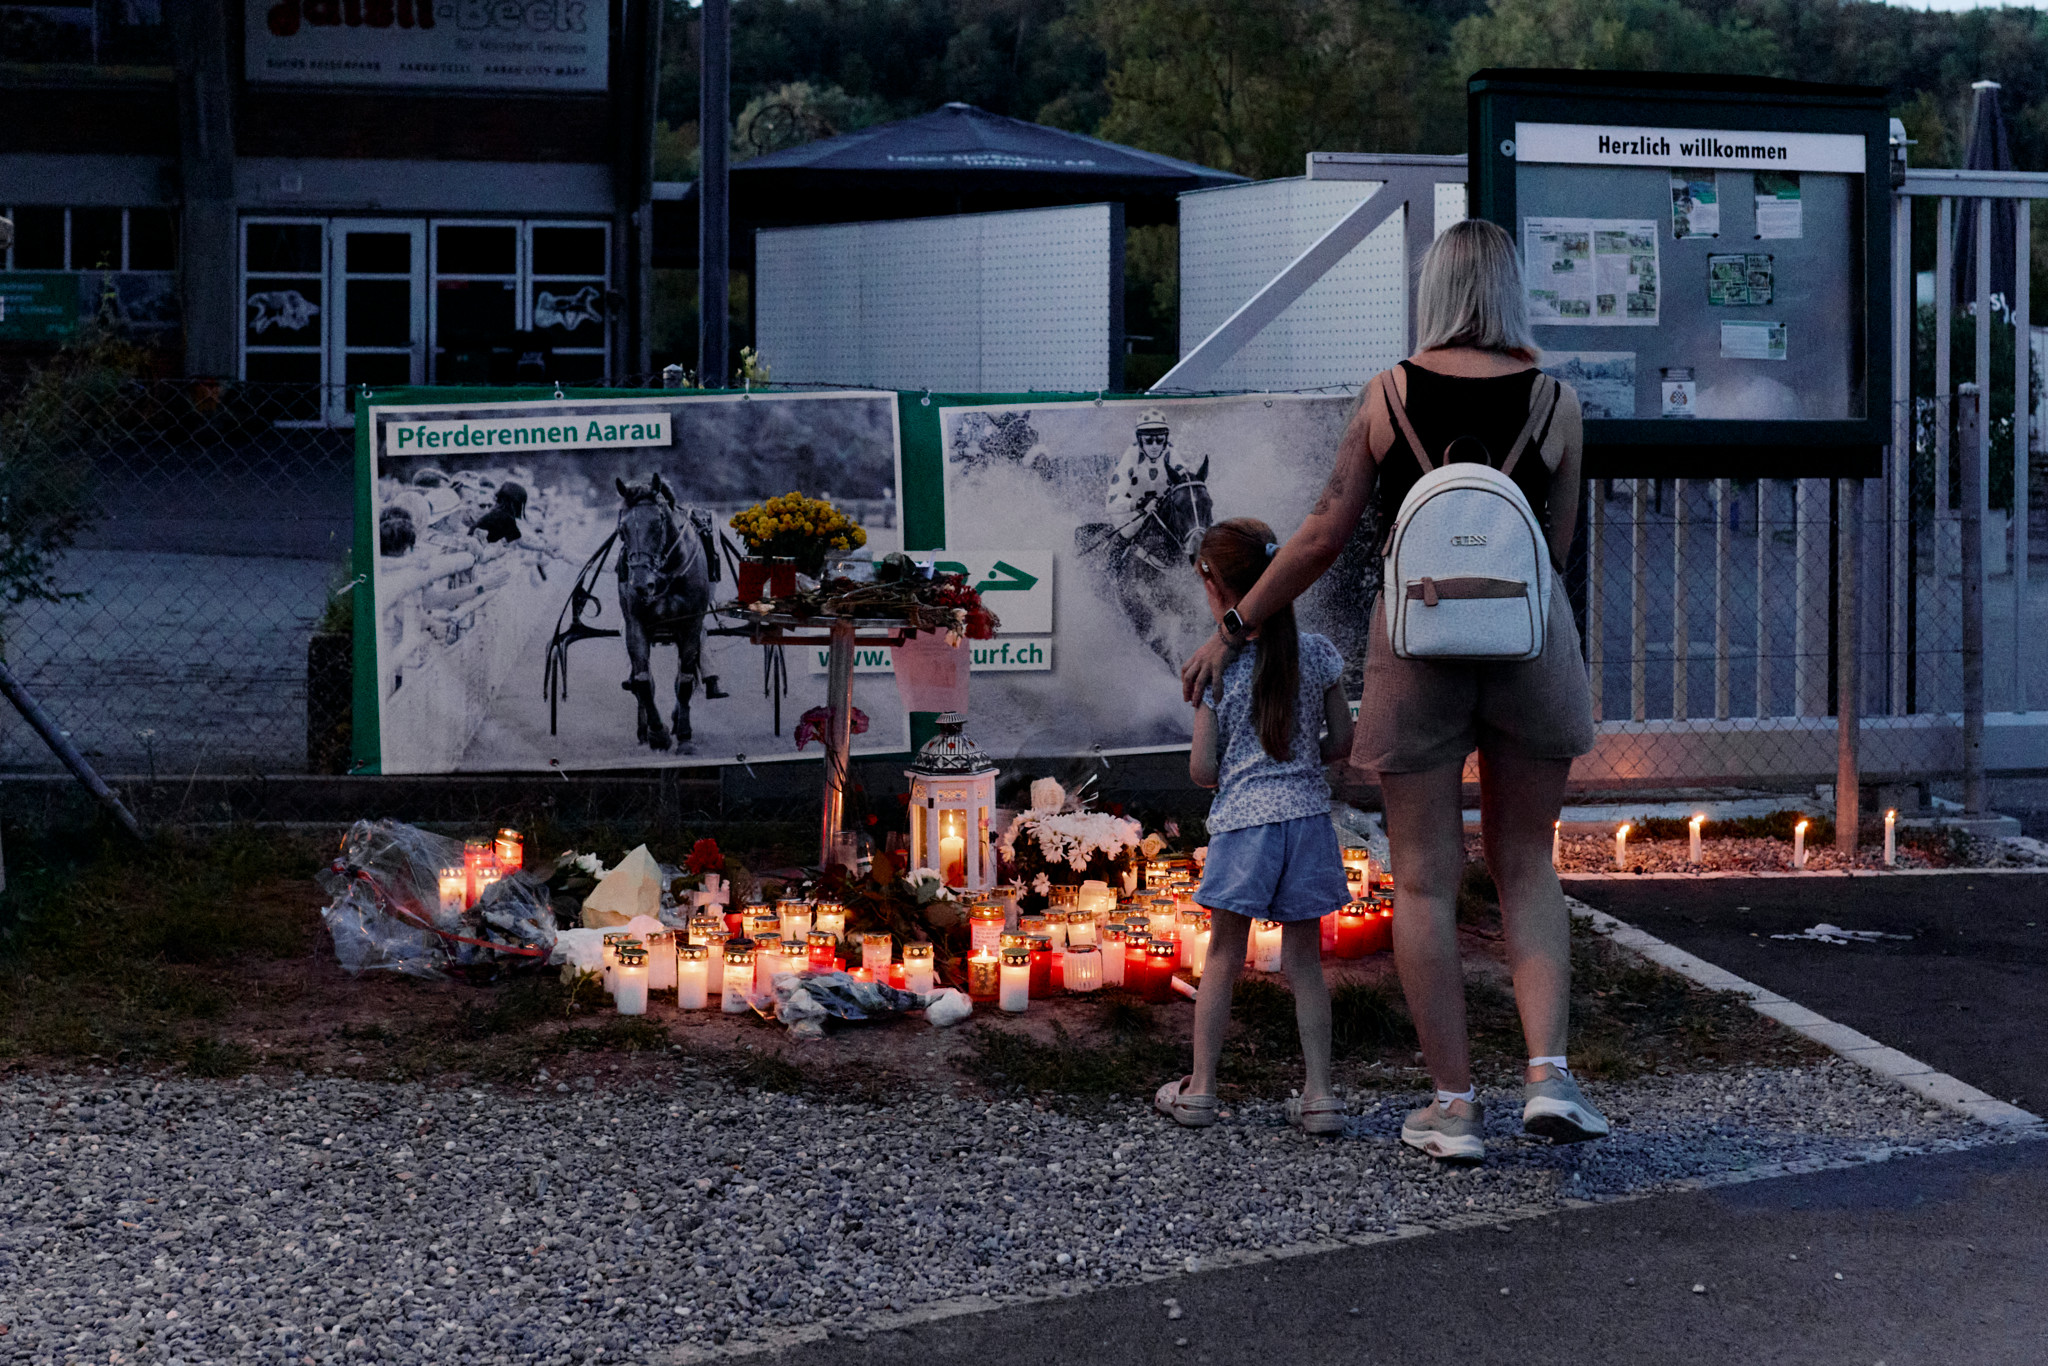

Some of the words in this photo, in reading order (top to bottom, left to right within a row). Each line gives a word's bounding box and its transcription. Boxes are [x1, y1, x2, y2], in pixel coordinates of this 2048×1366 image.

[1599, 135, 1670, 155] Herzlich
[1680, 138, 1787, 159] willkommen
[397, 423, 578, 449] Pferderennen
[585, 420, 661, 441] Aarau
[1450, 535, 1487, 546] GUESS
